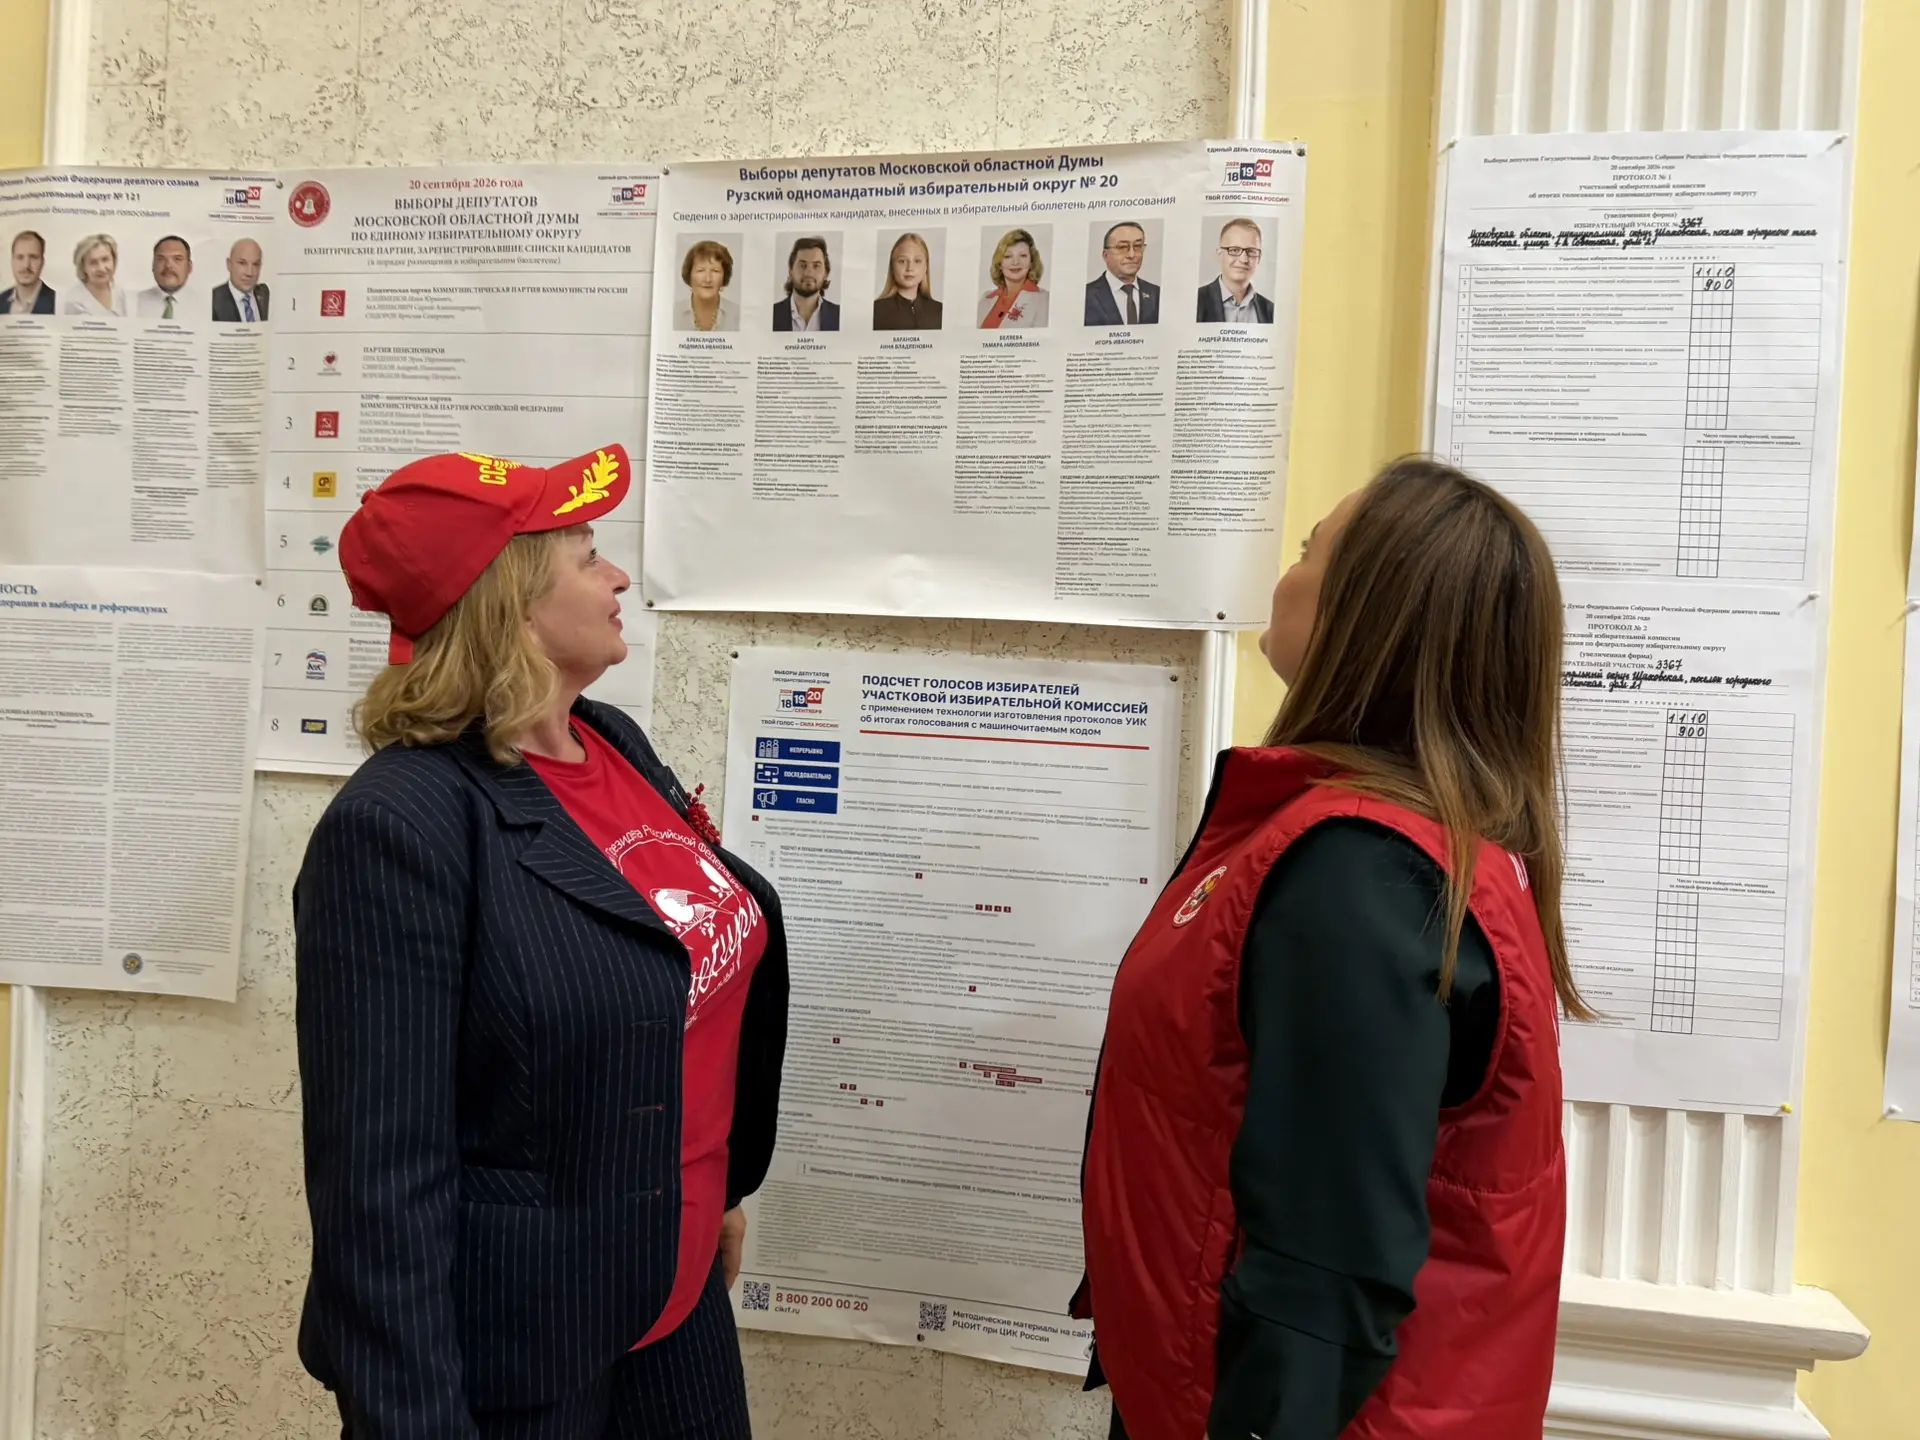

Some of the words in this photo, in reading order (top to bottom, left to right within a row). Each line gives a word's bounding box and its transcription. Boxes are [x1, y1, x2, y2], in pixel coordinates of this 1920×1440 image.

[740, 166, 798, 183] Выборы
[802, 164, 875, 182] депутатов
[880, 159, 970, 176] Московской
[974, 155, 1054, 172] областной
[1058, 155, 1103, 171] Думы
[1228, 172, 1238, 182] 18
[1242, 167, 1254, 176] 19
[1256, 163, 1270, 174] 20
[410, 180, 420, 190] 20
[422, 178, 470, 192] сентября
[473, 178, 498, 188] 2026
[500, 180, 522, 188] года
[726, 187, 784, 204] Рузский
[787, 184, 905, 202] одномандатный
[910, 179, 1028, 197] избирательный
[1033, 180, 1076, 193] округ
[1080, 176, 1096, 188] №
[1100, 175, 1118, 188] 20
[126, 192, 140, 200] 121
[395, 198, 453, 210] ВЫБОРЫ
[456, 196, 538, 210] ДЕПУТАТОВ
[673, 212, 718, 222] Сведения
[729, 211, 828, 222] зарегистрированных
[830, 209, 887, 220] кандидатах,
[889, 207, 940, 216] внесенных
[951, 202, 1028, 216] избирательный
[1031, 201, 1086, 212] бюллетень
[1088, 200, 1106, 210] для
[1109, 196, 1176, 208] голосования
[354, 213, 446, 228] МОСКОВСКОЙ
[450, 212, 533, 226] ОБЛАСТНОЙ
[536, 213, 580, 226] ДУМЫ
[1678, 216, 1704, 228] 3367
[351, 232, 368, 241] ПО
[370, 231, 425, 242] ЕДИНОМУ
[428, 230, 535, 240] ИЗБИРАТЕЛЬНОМУ
[536, 229, 582, 240] ОКРУГУ
[304, 247, 375, 256] ПОЛИТИЧЕСКИЕ
[376, 247, 416, 256] ПАРТИИ,
[418, 245, 524, 255] ЗАРЕГИСТРИРОВАВШИЕ
[524, 245, 565, 253] СПИСКИ
[567, 245, 632, 254] КАНДИДАТОВ
[1704, 278, 1732, 291] 900
[288, 357, 296, 370] 2
[286, 416, 292, 430] 3
[283, 476, 290, 489] 4
[280, 535, 288, 548] 5
[278, 595, 285, 607] 6
[1594, 634, 1646, 642] избирательной
[1595, 641, 1644, 650] федеральному
[1646, 643, 1702, 652] избирательному
[274, 653, 282, 666] 7
[1655, 659, 1682, 670] 3367
[862, 676, 920, 687] ПОДСЧЕТ
[924, 679, 983, 691] ГОЛОСОВ
[986, 682, 1080, 696] ИЗБИРАТЕЛЕЙ
[1608, 680, 1628, 692] дом
[1630, 680, 1642, 690] 21
[782, 699, 792, 708] 18
[794, 694, 806, 704] 19
[808, 691, 820, 700] 20
[862, 690, 946, 704] УЧАСТКОВОЙ
[950, 695, 1061, 710] ИЗБИРАТЕЛЬНОЙ
[1065, 700, 1148, 714] КОМИССИЕЙ
[868, 704, 934, 714] применением
[936, 708, 992, 718] технологии
[994, 712, 1062, 722] изготовления
[1064, 716, 1123, 725] протоколов
[1126, 717, 1147, 726] УИК
[1668, 713, 1706, 724] 1110
[271, 719, 279, 732] 8
[874, 716, 905, 724] итогах
[908, 718, 969, 728] голосования
[980, 722, 1068, 734] машиночитаемым
[1070, 728, 1101, 736] кодом
[1678, 726, 1705, 737] 900
[784, 771, 832, 780] ПОСЛЕДОВАТЕЛЬНО
[776, 1292, 783, 1302] 8
[786, 1294, 808, 1304] 800
[811, 1296, 832, 1307] 200
[836, 1299, 850, 1309] 00
[853, 1301, 868, 1312] 20
[774, 1306, 800, 1314] cikrf.ru
[952, 1310, 1012, 1326] Методические
[1013, 1321, 1058, 1334] материалы
[952, 1320, 981, 1332] РЦОИТ
[982, 1326, 998, 1335] при
[1000, 1328, 1018, 1338] ЦИК
[1020, 1332, 1050, 1342] России
